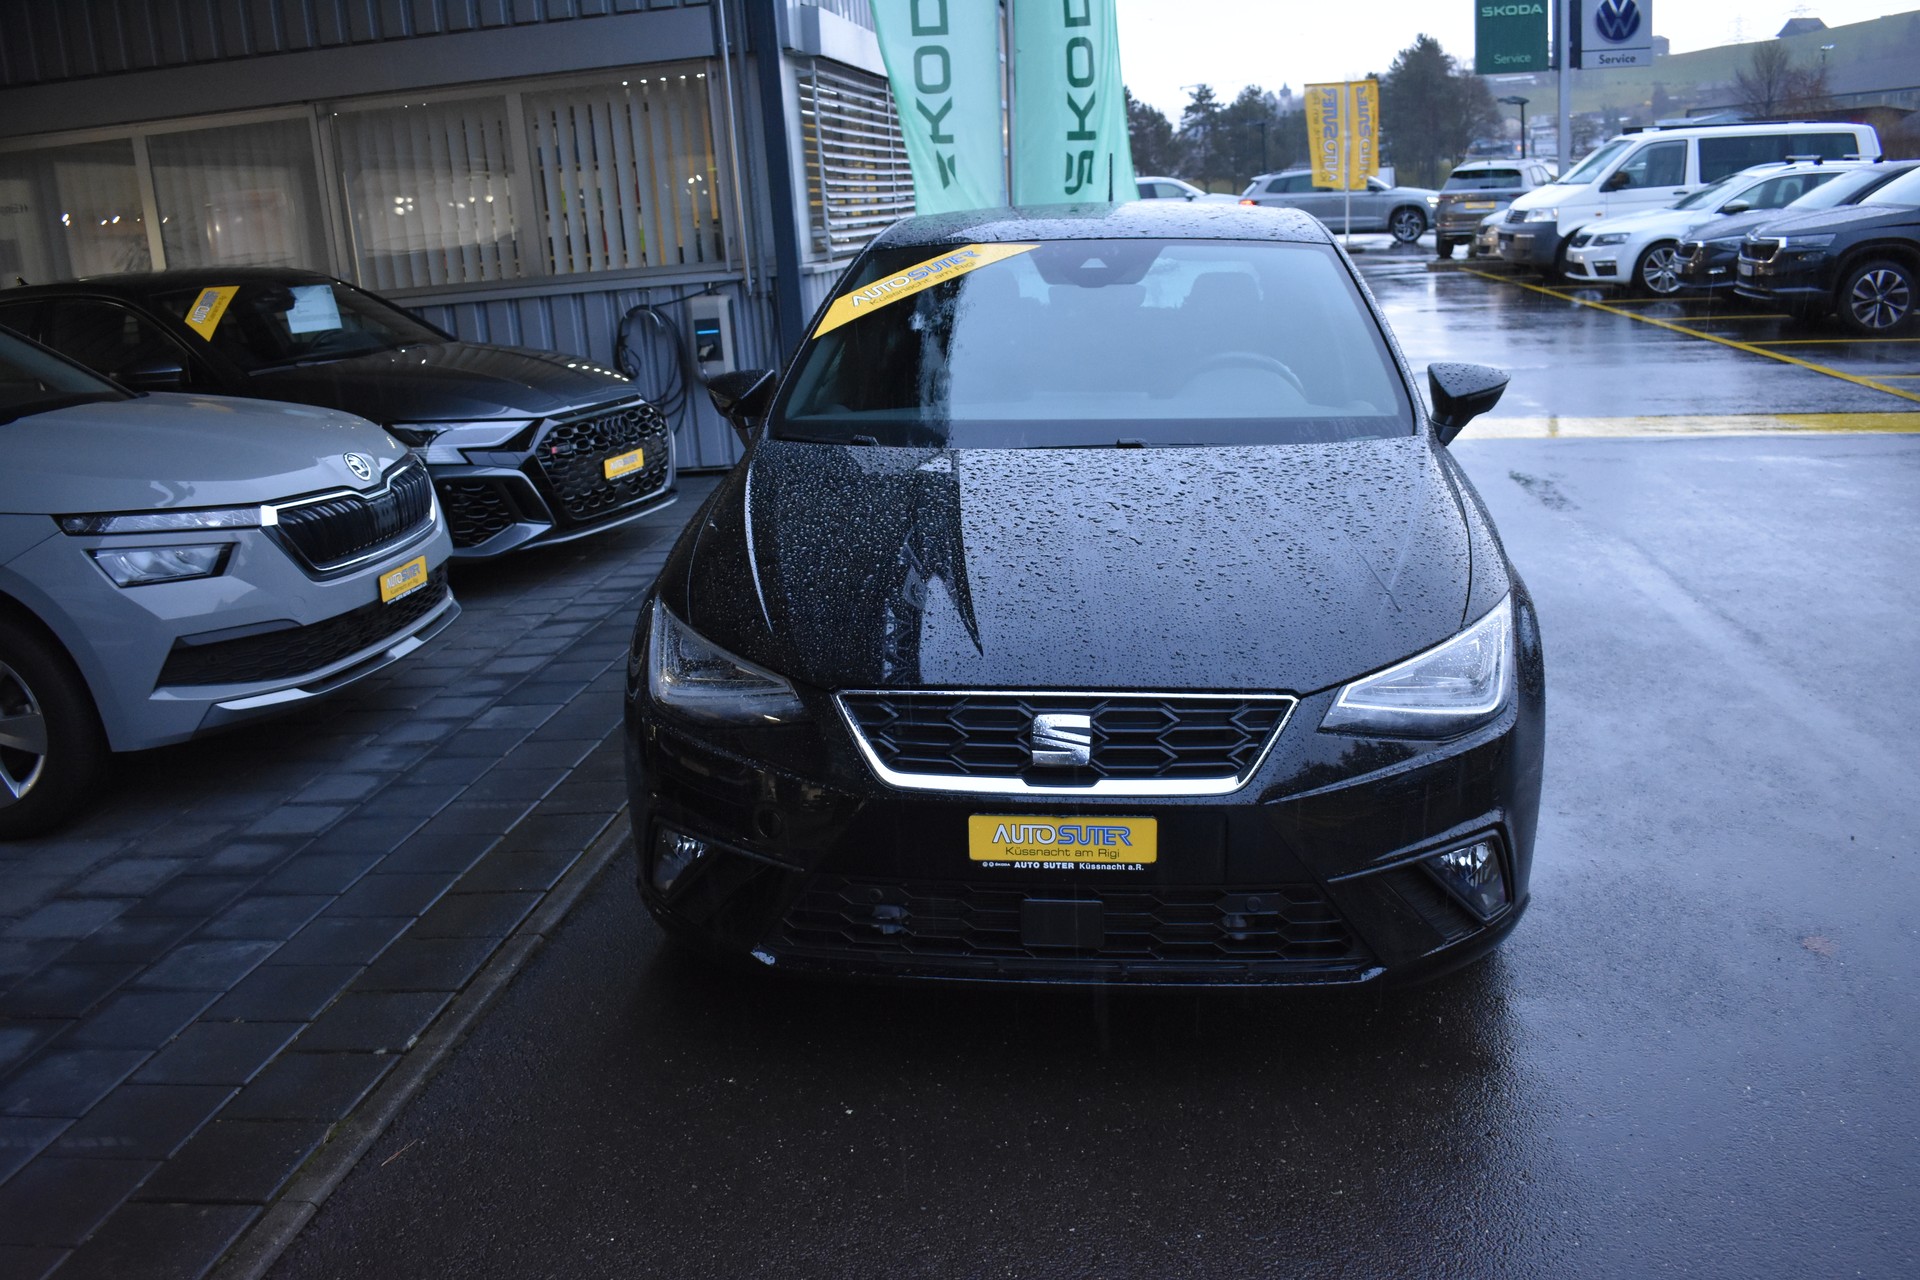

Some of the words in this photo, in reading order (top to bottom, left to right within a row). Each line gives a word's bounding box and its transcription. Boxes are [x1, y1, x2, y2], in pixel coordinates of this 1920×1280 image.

[1493, 53, 1532, 65] Service
[1598, 55, 1636, 65] Service
[1005, 846, 1071, 857] Küssnacht
[1098, 848, 1121, 860] Rigi
[1079, 862, 1126, 871] Küssnacht
